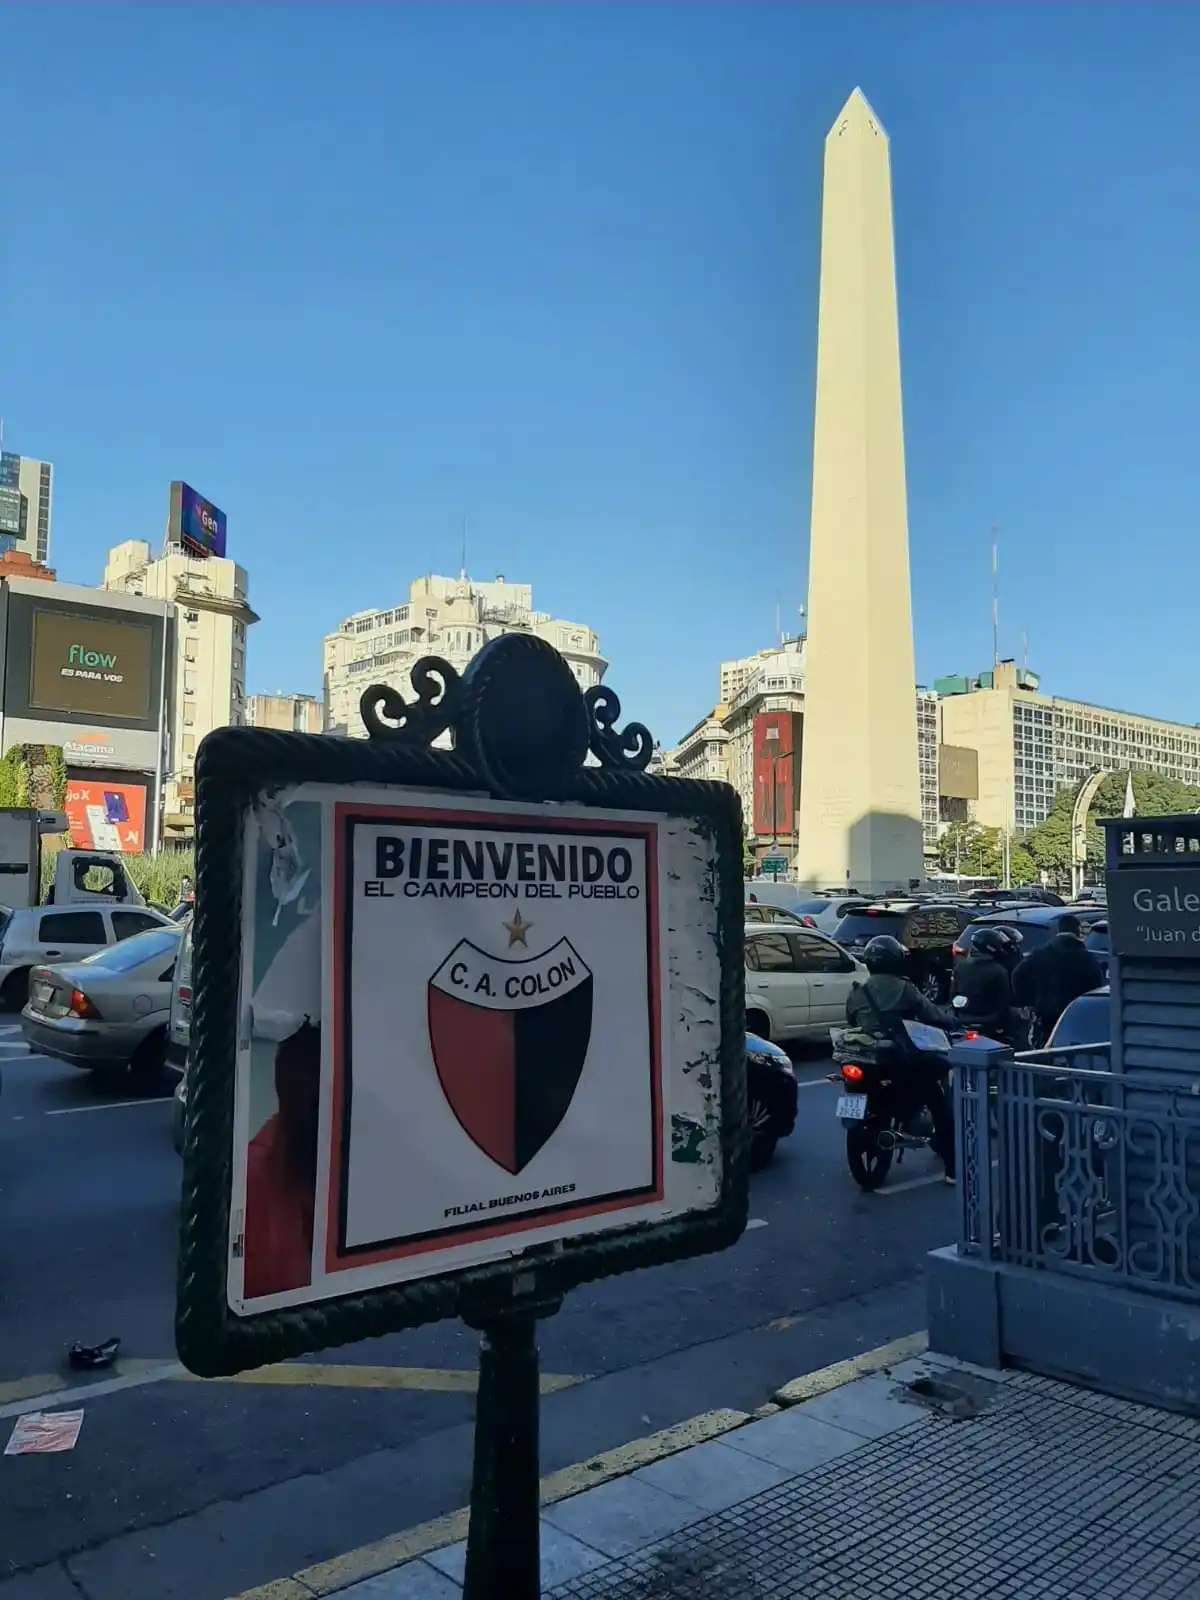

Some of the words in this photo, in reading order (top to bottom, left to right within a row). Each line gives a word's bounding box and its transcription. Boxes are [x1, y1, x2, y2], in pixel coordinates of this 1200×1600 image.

[202, 510, 217, 533] Gen
[69, 644, 116, 668] flow
[61, 668, 75, 676] ES
[75, 670, 101, 680] PARA
[104, 673, 124, 682] VOS
[63, 741, 114, 754] Atacama
[375, 836, 632, 883] BIENVENIDO
[364, 881, 394, 897] EL
[404, 881, 518, 898] CAMPEON
[525, 883, 562, 898] DEL
[568, 884, 640, 899] PUEBLO
[1133, 886, 1200, 912] Gale
[504, 957, 576, 998] COLON
[444, 1202, 487, 1218] FILIAL
[488, 1191, 540, 1209] BUENOS
[541, 1183, 576, 1198] AIRES
